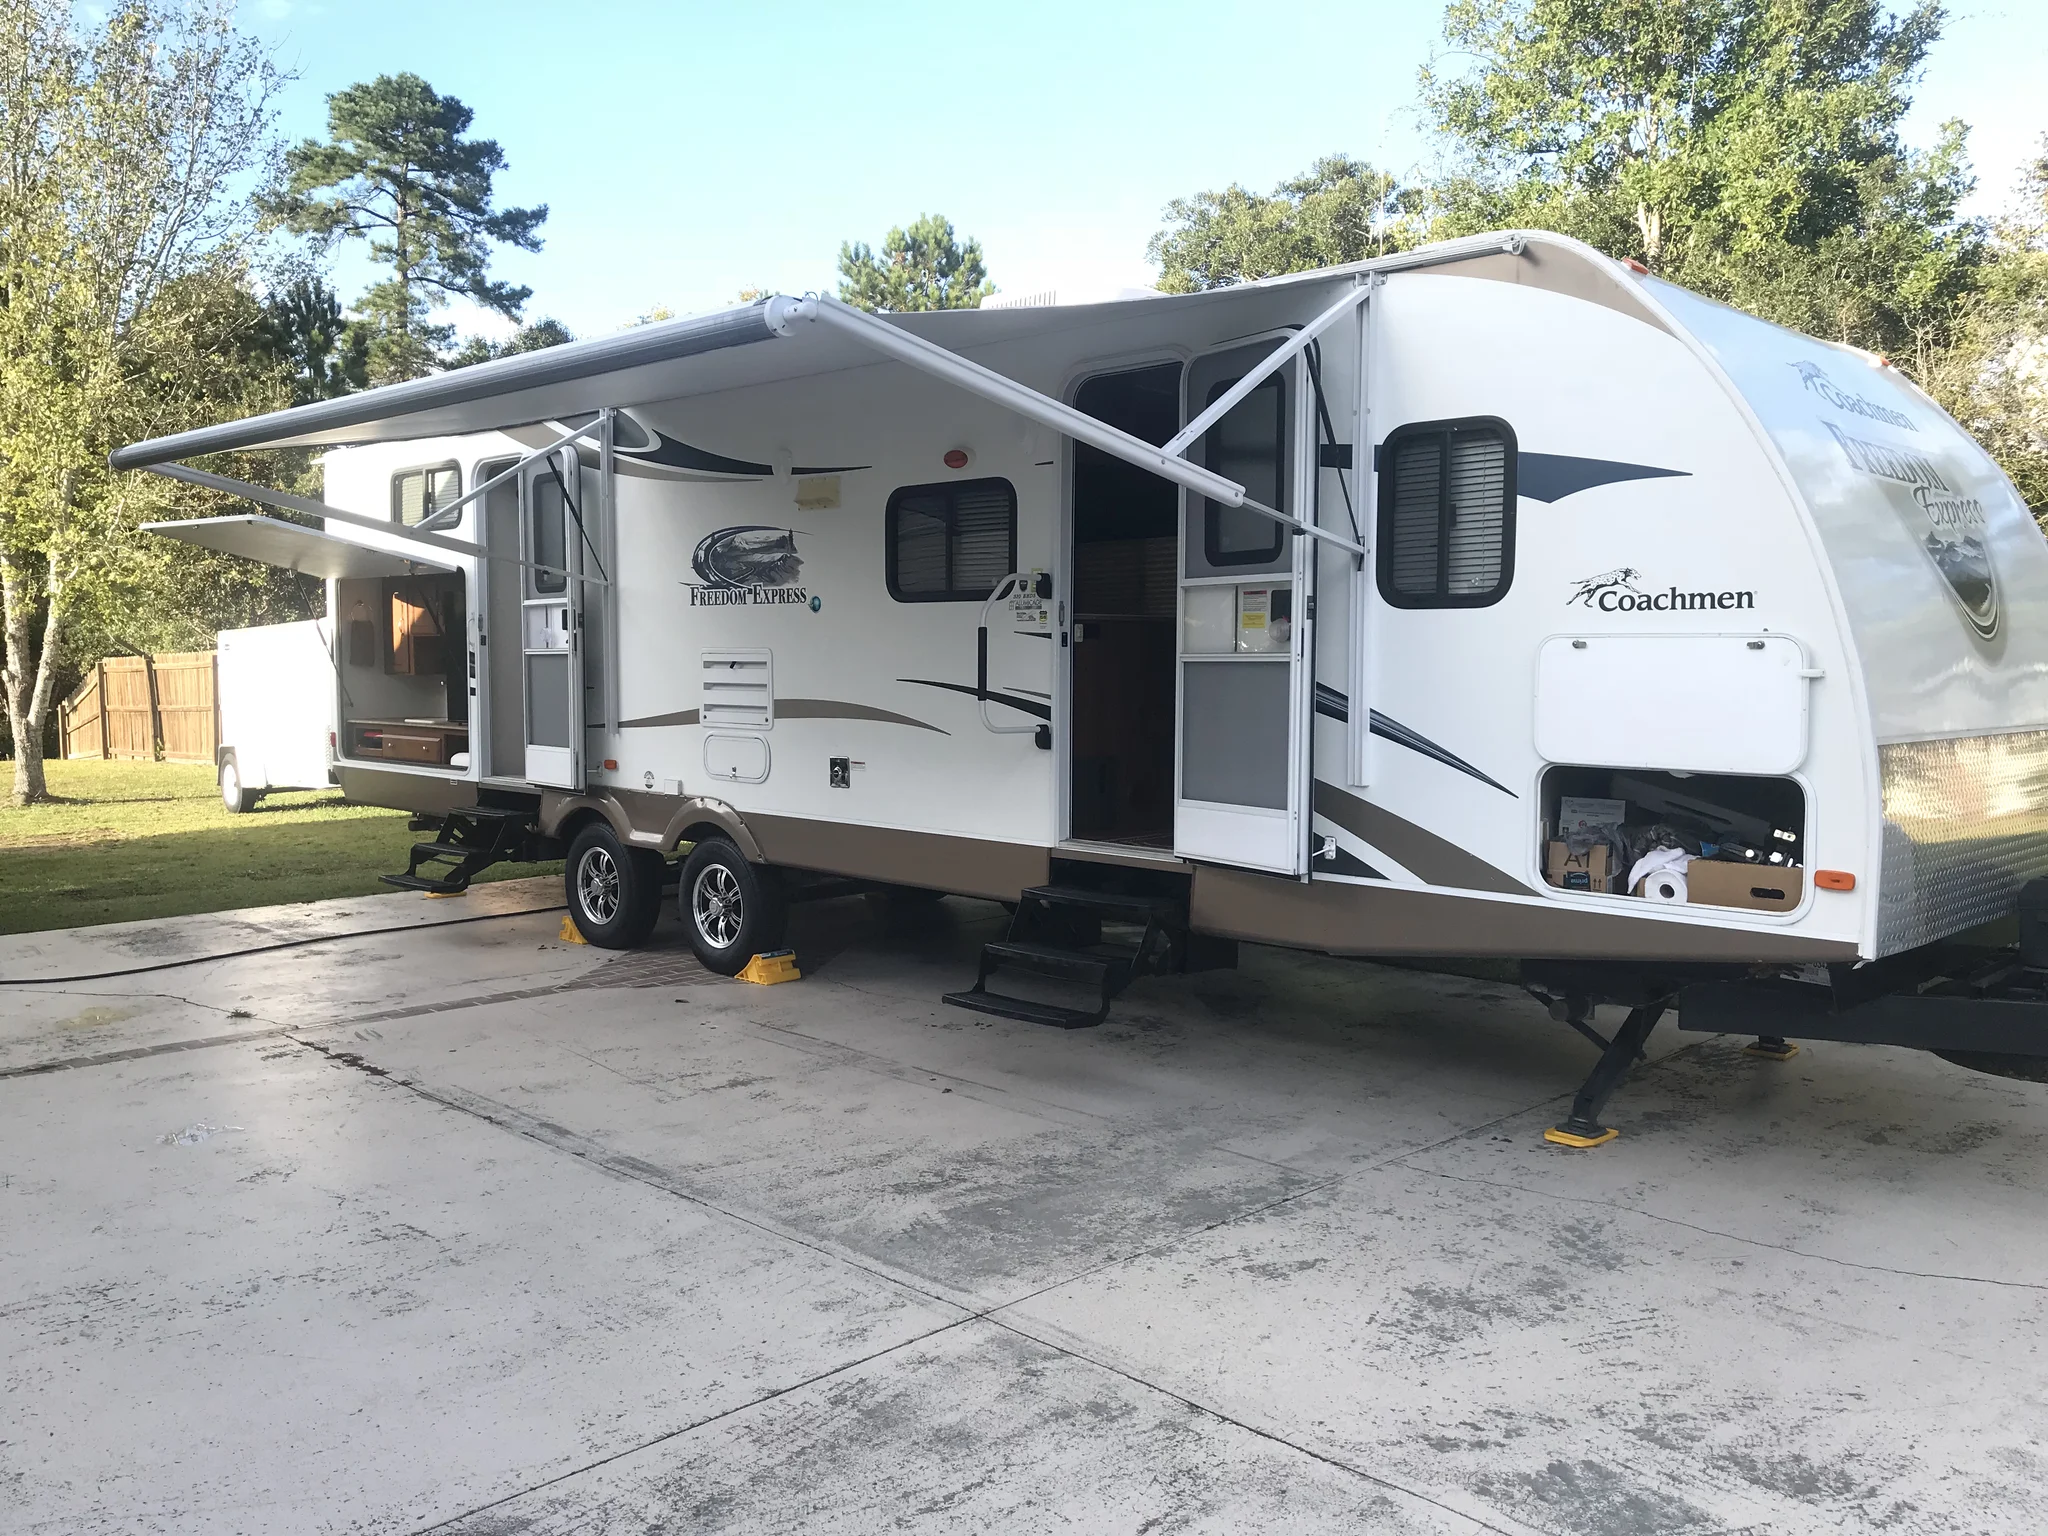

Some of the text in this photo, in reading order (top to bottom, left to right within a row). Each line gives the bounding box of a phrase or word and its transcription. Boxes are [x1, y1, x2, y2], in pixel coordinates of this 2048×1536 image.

[1820, 383, 1919, 432] Coachmen
[1820, 419, 1950, 492] FREEDOM
[1913, 485, 1985, 534] Express
[690, 583, 807, 606] FREEDOM EXPRESS
[1598, 586, 1755, 612] Coachmen
